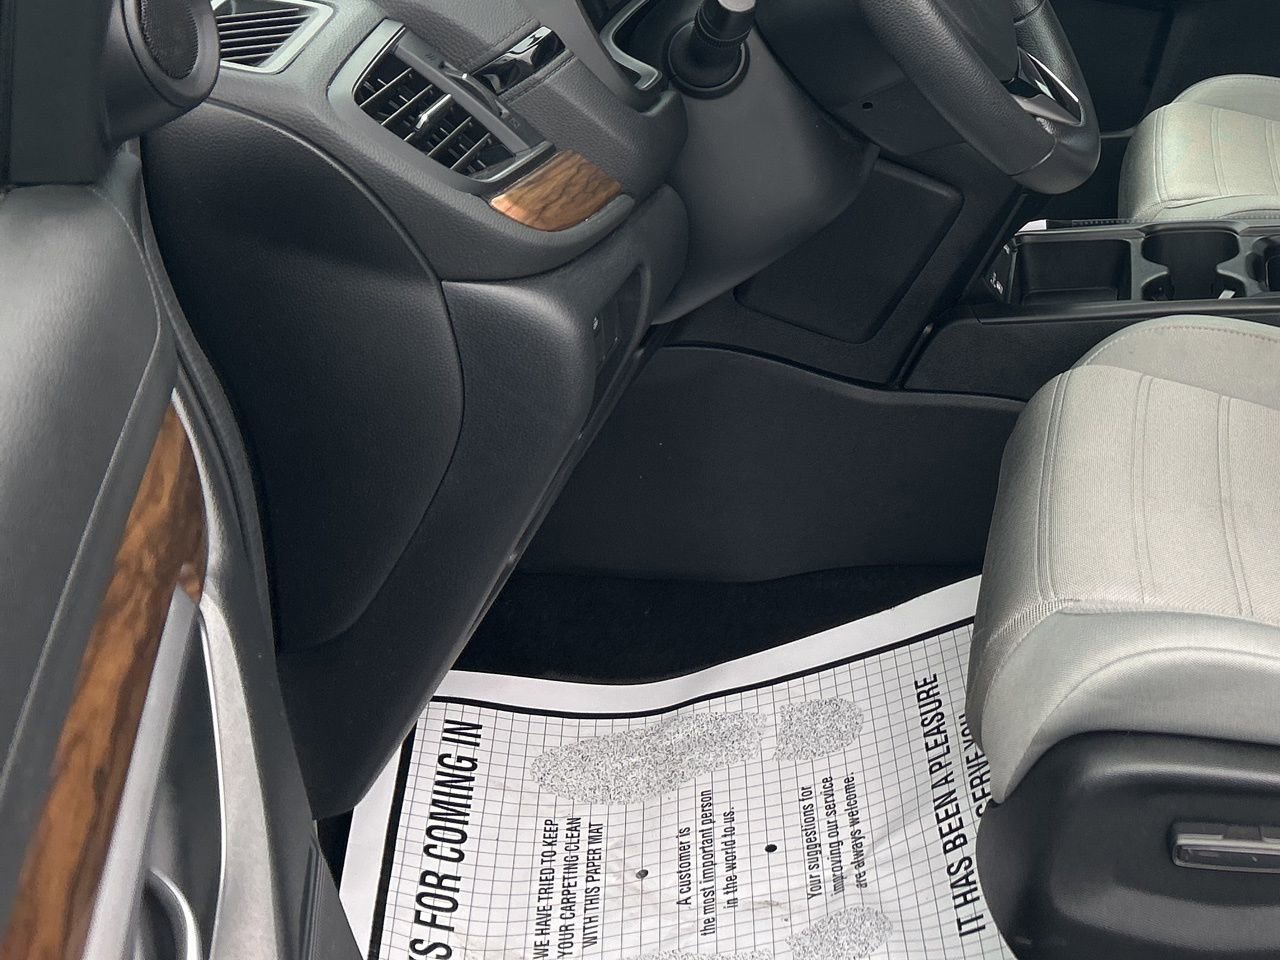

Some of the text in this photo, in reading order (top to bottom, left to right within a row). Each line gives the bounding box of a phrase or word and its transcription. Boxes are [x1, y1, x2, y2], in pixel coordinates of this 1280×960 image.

[441, 719, 483, 747] IN
[914, 673, 954, 776] PLEASURE
[423, 753, 478, 863] COMING
[844, 771, 868, 889] are always welcome.
[931, 773, 955, 790] A
[933, 788, 968, 856] BEEN
[557, 817, 582, 959] YOUR CARPETING CLEAN
[582, 822, 604, 949] WITH THIS PAPER MAT
[676, 826, 692, 906] A customer is
[699, 789, 717, 936] the most important person
[721, 806, 739, 909] in the world to us.
[799, 786, 822, 900] Your suggestions for
[820, 776, 848, 897] improving our service
[946, 855, 980, 909] HAS
[414, 869, 461, 932] FOR
[533, 819, 559, 959] WE HAVE TRIED TO KEEP
[956, 914, 987, 938] IT
